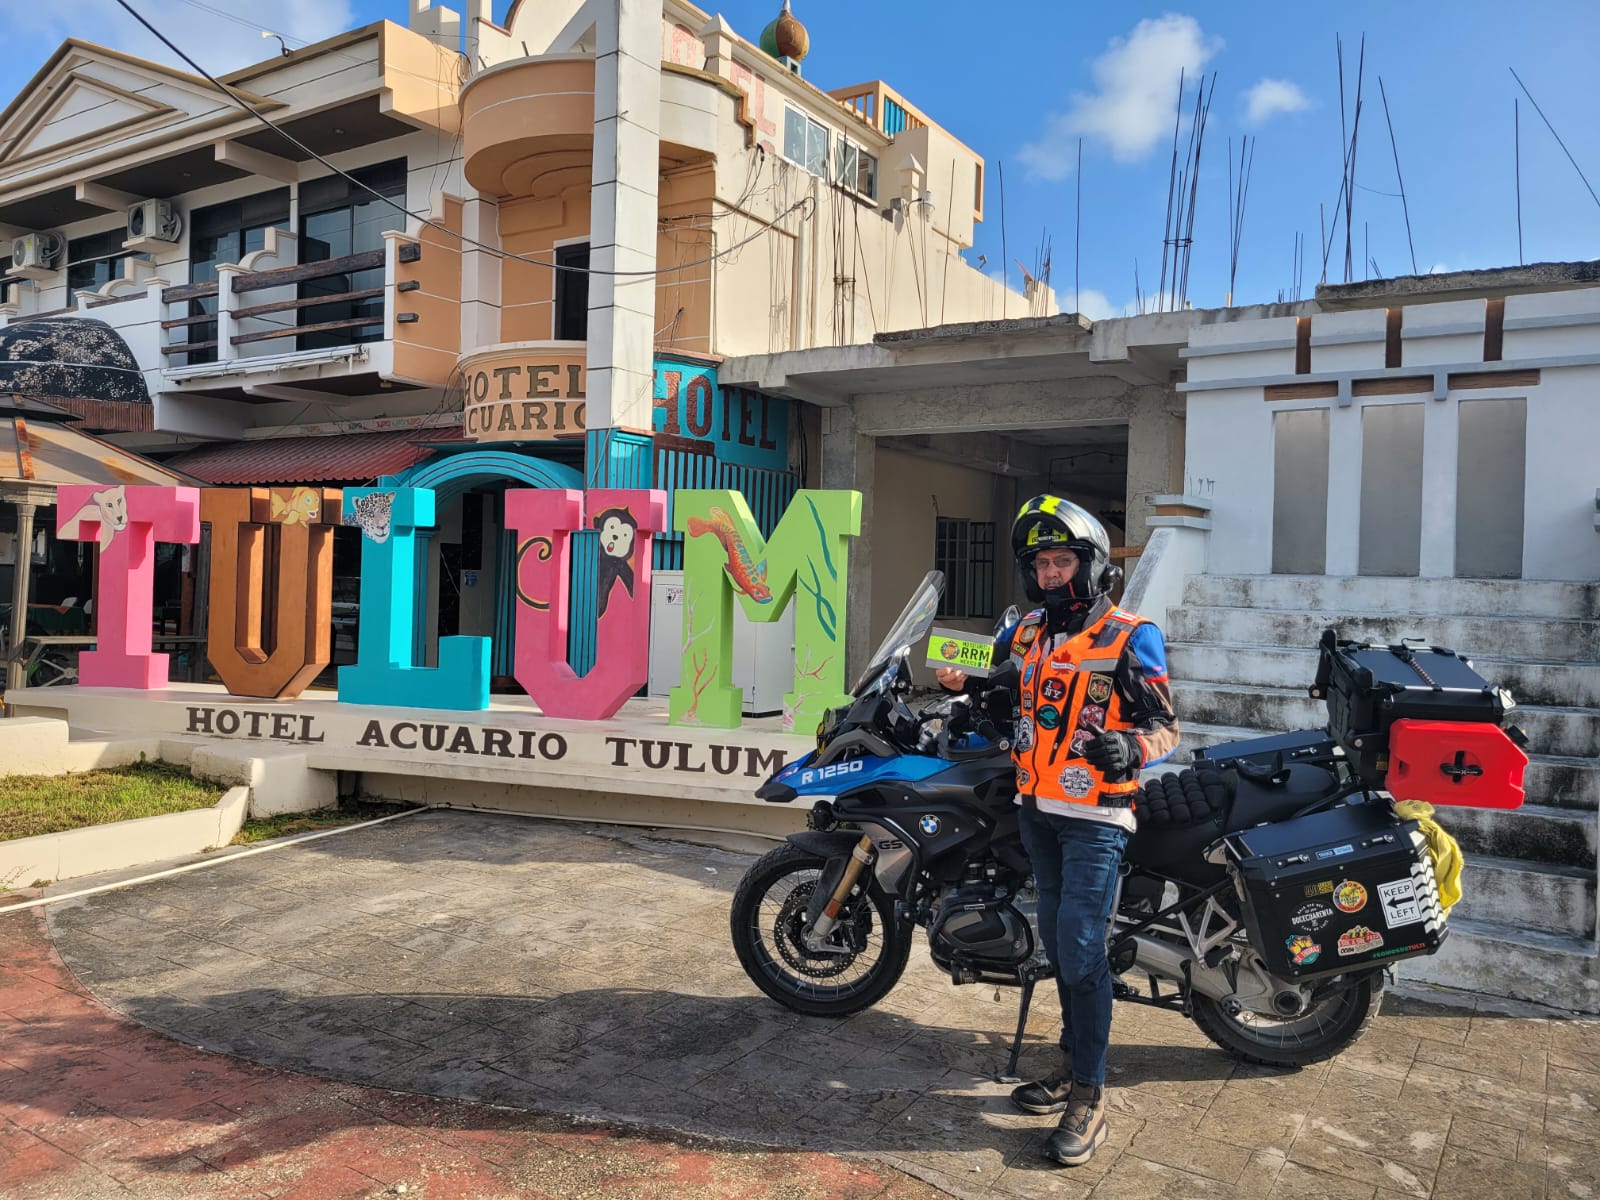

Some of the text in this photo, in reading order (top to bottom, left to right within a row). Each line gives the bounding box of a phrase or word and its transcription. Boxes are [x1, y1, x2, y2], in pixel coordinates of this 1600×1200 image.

[464, 402, 586, 436] CUARI
[57, 484, 863, 736] TULUM
[960, 647, 990, 662] RRM
[1044, 687, 1063, 699] NY
[185, 706, 788, 778] HOTEL ACUARIO TULUM
[801, 760, 863, 785] R 1250
[878, 840, 904, 850] GS
[1383, 884, 1410, 898] KEEP
[1390, 906, 1415, 919] LEFT
